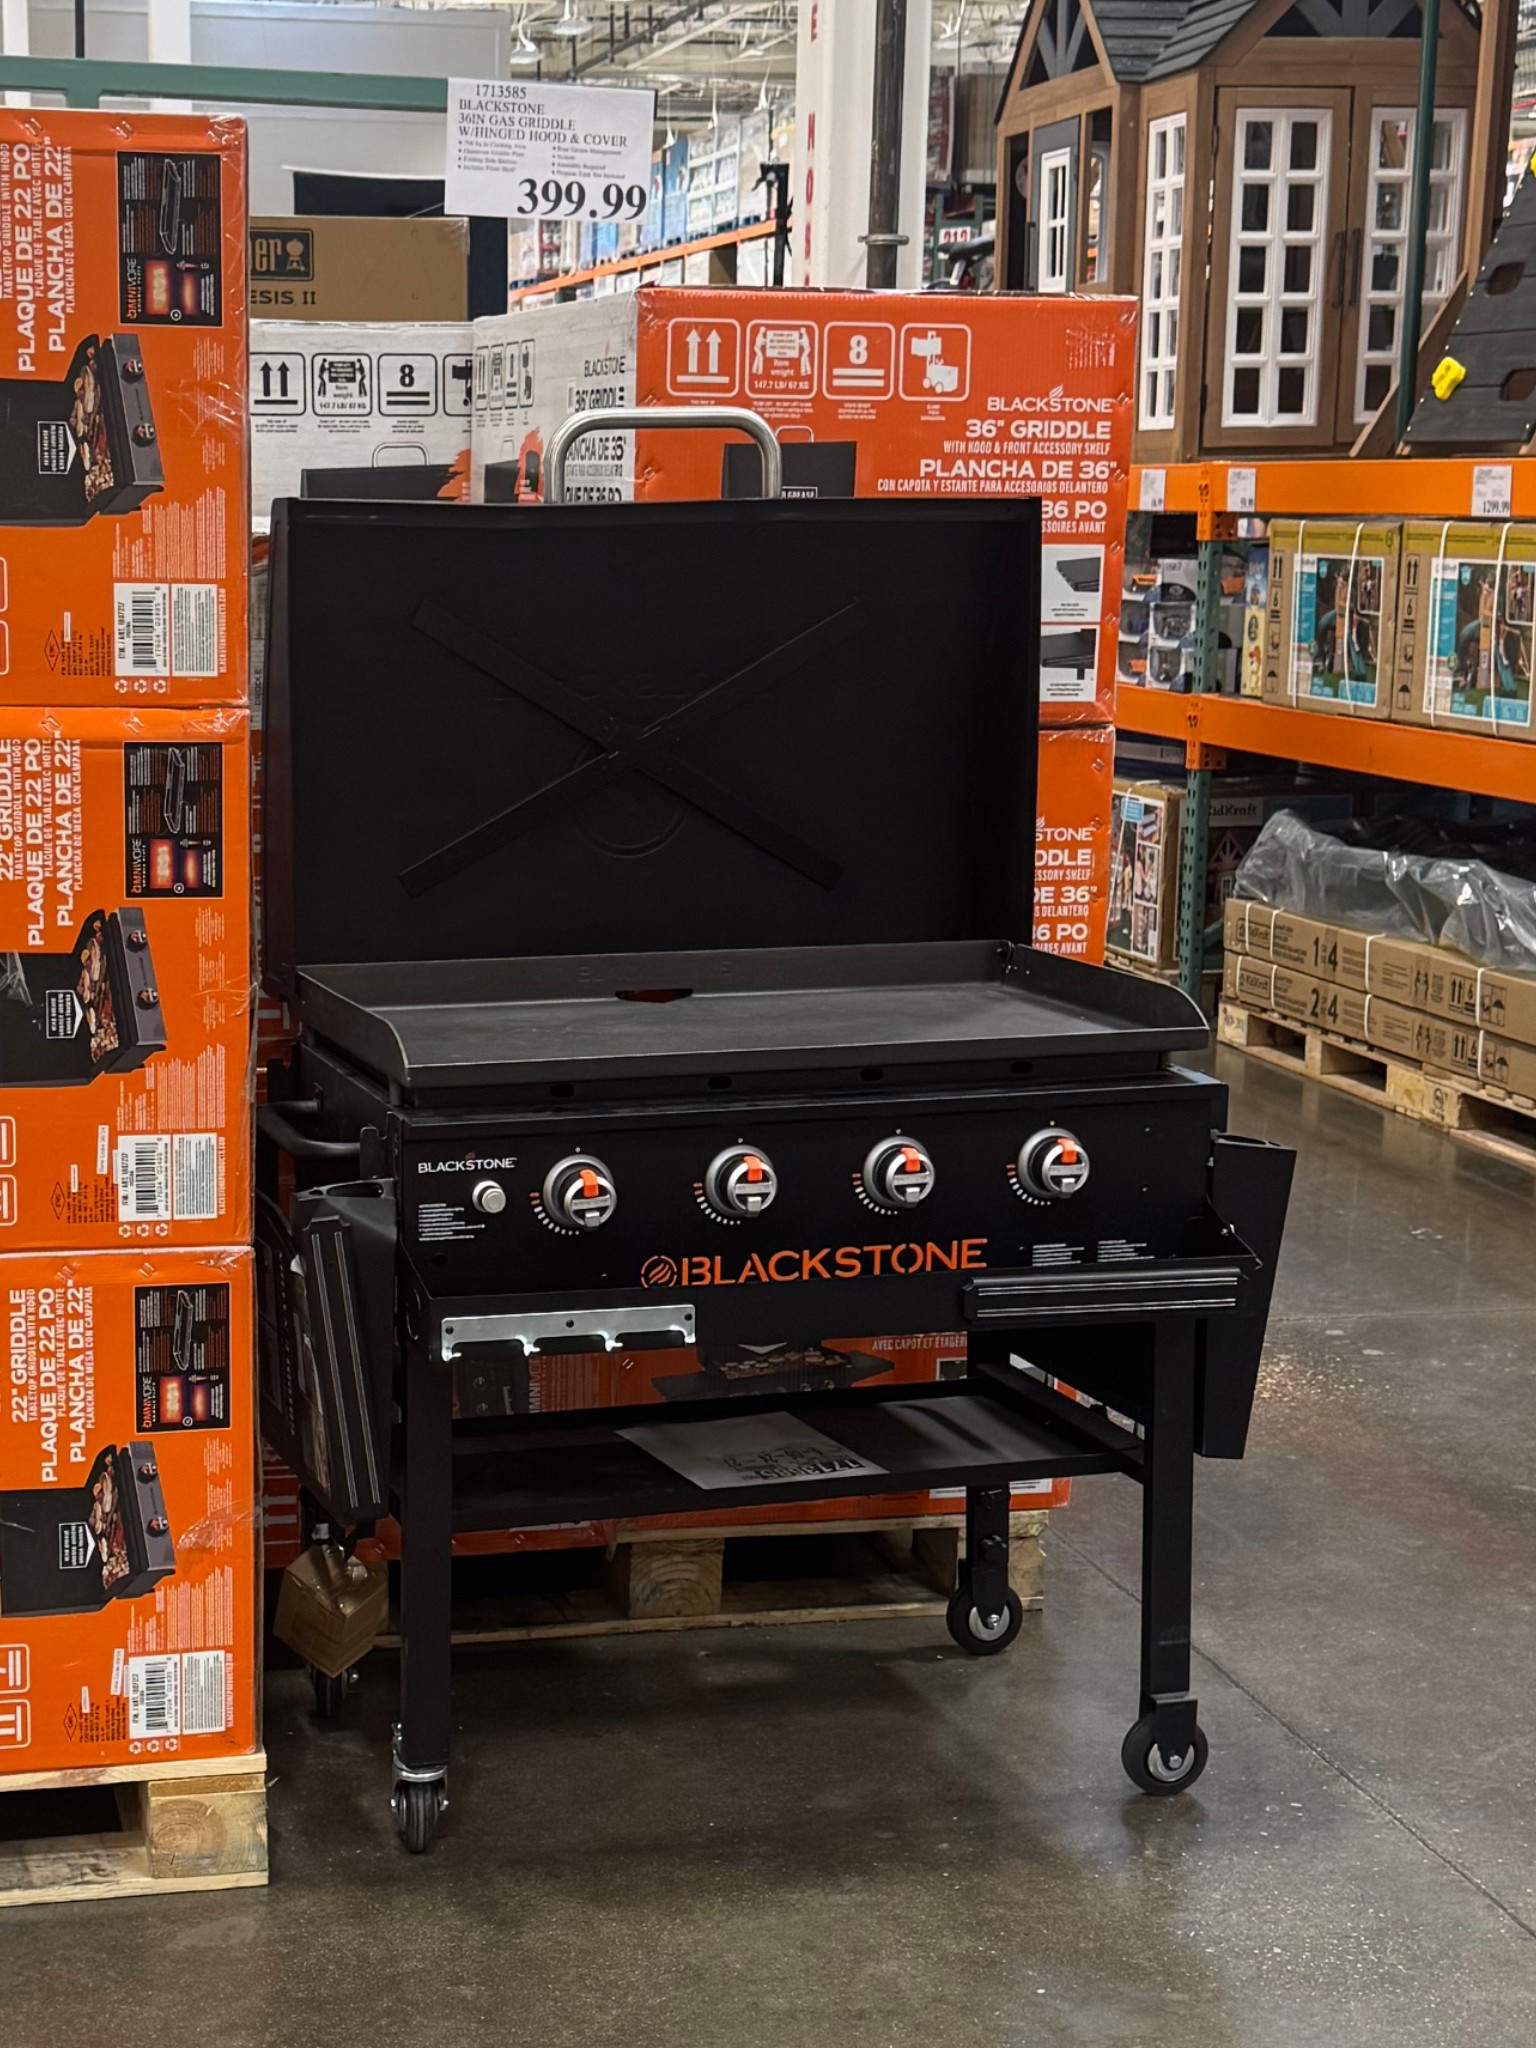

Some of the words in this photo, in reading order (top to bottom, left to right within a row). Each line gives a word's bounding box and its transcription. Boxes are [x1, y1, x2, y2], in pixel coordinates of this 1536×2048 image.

[475, 84, 527, 99] 1713585
[458, 113, 486, 126] 36IN
[489, 115, 516, 128] GAS
[519, 117, 576, 131] GRIDDLE
[459, 99, 544, 115] BLACKSTONE
[458, 126, 526, 141] W/HINGED
[529, 130, 567, 143] HOOD
[570, 133, 580, 144] &
[583, 133, 628, 147] COVER
[12, 143, 31, 181] PO
[43, 135, 63, 177] 22"
[14, 187, 32, 220] 22
[46, 183, 64, 219] DE
[517, 178, 647, 221] 399.99
[15, 226, 33, 261] DE
[47, 225, 66, 352] PLANCHA
[303, 291, 316, 304] II
[16, 266, 36, 372] PLAQUE
[849, 335, 868, 365] 8
[399, 364, 415, 388] 8
[584, 356, 626, 378] BLACKSTONE
[589, 386, 624, 409] GRIDDLE
[987, 396, 1113, 413] BLACKSTONE
[966, 419, 1004, 438] 36"
[1010, 420, 1111, 439] GRIDDLE
[598, 437, 609, 460] DE
[943, 440, 965, 453] WITH
[968, 440, 992, 454] HOOD
[994, 441, 1001, 454] &
[1003, 441, 1031, 455] FRONT
[1032, 441, 1083, 455] ACCESSORY
[1084, 442, 1111, 456] SHELF
[920, 459, 1036, 478] PLANCHA
[1041, 460, 1074, 479] DE
[1078, 460, 1117, 480] 36"
[877, 478, 896, 492] CON
[897, 479, 931, 492] CAPOTA
[932, 479, 939, 492] Y
[941, 479, 977, 493] ESTANTE
[979, 479, 1001, 493] PARA
[1004, 480, 1057, 493] ACCESORIOS
[1059, 480, 1108, 494] DELANTERO
[1074, 500, 1107, 519] PO
[1078, 520, 1106, 534] AVANT
[24, 738, 42, 772] PO
[53, 730, 72, 769] 22"
[25, 778, 43, 807] 22
[55, 772, 72, 805] DE
[26, 812, 43, 844] DE
[56, 811, 74, 926] PLANCHA
[1065, 869, 1091, 881] SHELF
[27, 850, 45, 946] PLAQUE
[1061, 886, 1097, 903] 36"
[1042, 905, 1089, 918] DELANTERO
[1056, 924, 1088, 940] PO
[1314, 937, 1320, 967] 1
[1328, 942, 1338, 972] 4
[1310, 988, 1320, 1018] 2
[1328, 994, 1338, 1024] 4
[417, 1157, 518, 1174] BLACKSTONE
[682, 1238, 988, 1287] BLACKSTONE
[38, 1287, 55, 1320] PO
[67, 1279, 84, 1314] 22"
[9, 1289, 27, 1385] GRIDDLE
[39, 1324, 56, 1352] 22
[68, 1318, 84, 1350] DE
[872, 1338, 894, 1351] AVEC
[895, 1336, 922, 1350] CAPOT
[923, 1337, 933, 1349] ET
[40, 1357, 57, 1388] DE
[11, 1387, 28, 1423] 22"
[69, 1354, 86, 1463] PLANCHA
[41, 1392, 59, 1482] PLAQUE
